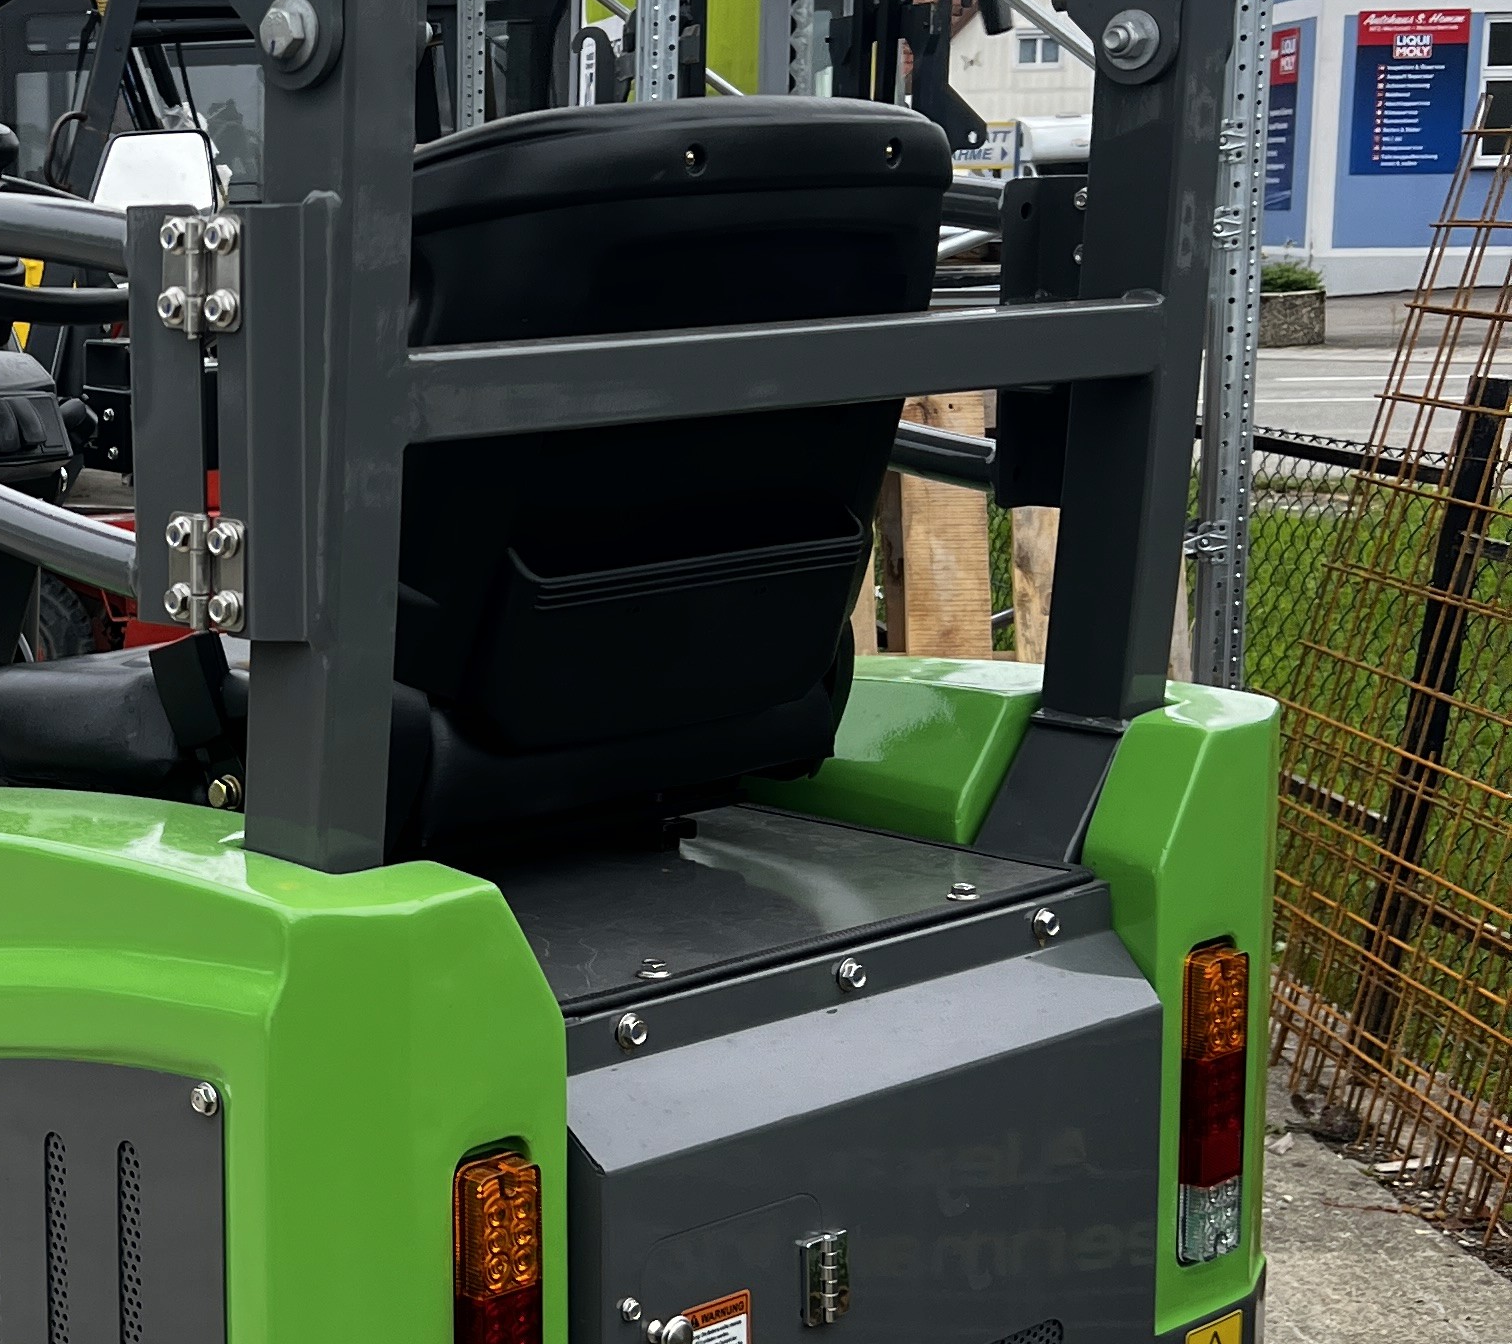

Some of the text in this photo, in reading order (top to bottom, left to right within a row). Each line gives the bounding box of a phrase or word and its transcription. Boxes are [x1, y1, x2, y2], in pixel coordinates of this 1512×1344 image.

[1396, 35, 1431, 46] LIQUI
[1395, 46, 1430, 57] MOLY
[701, 1301, 744, 1323] WARNUNG
